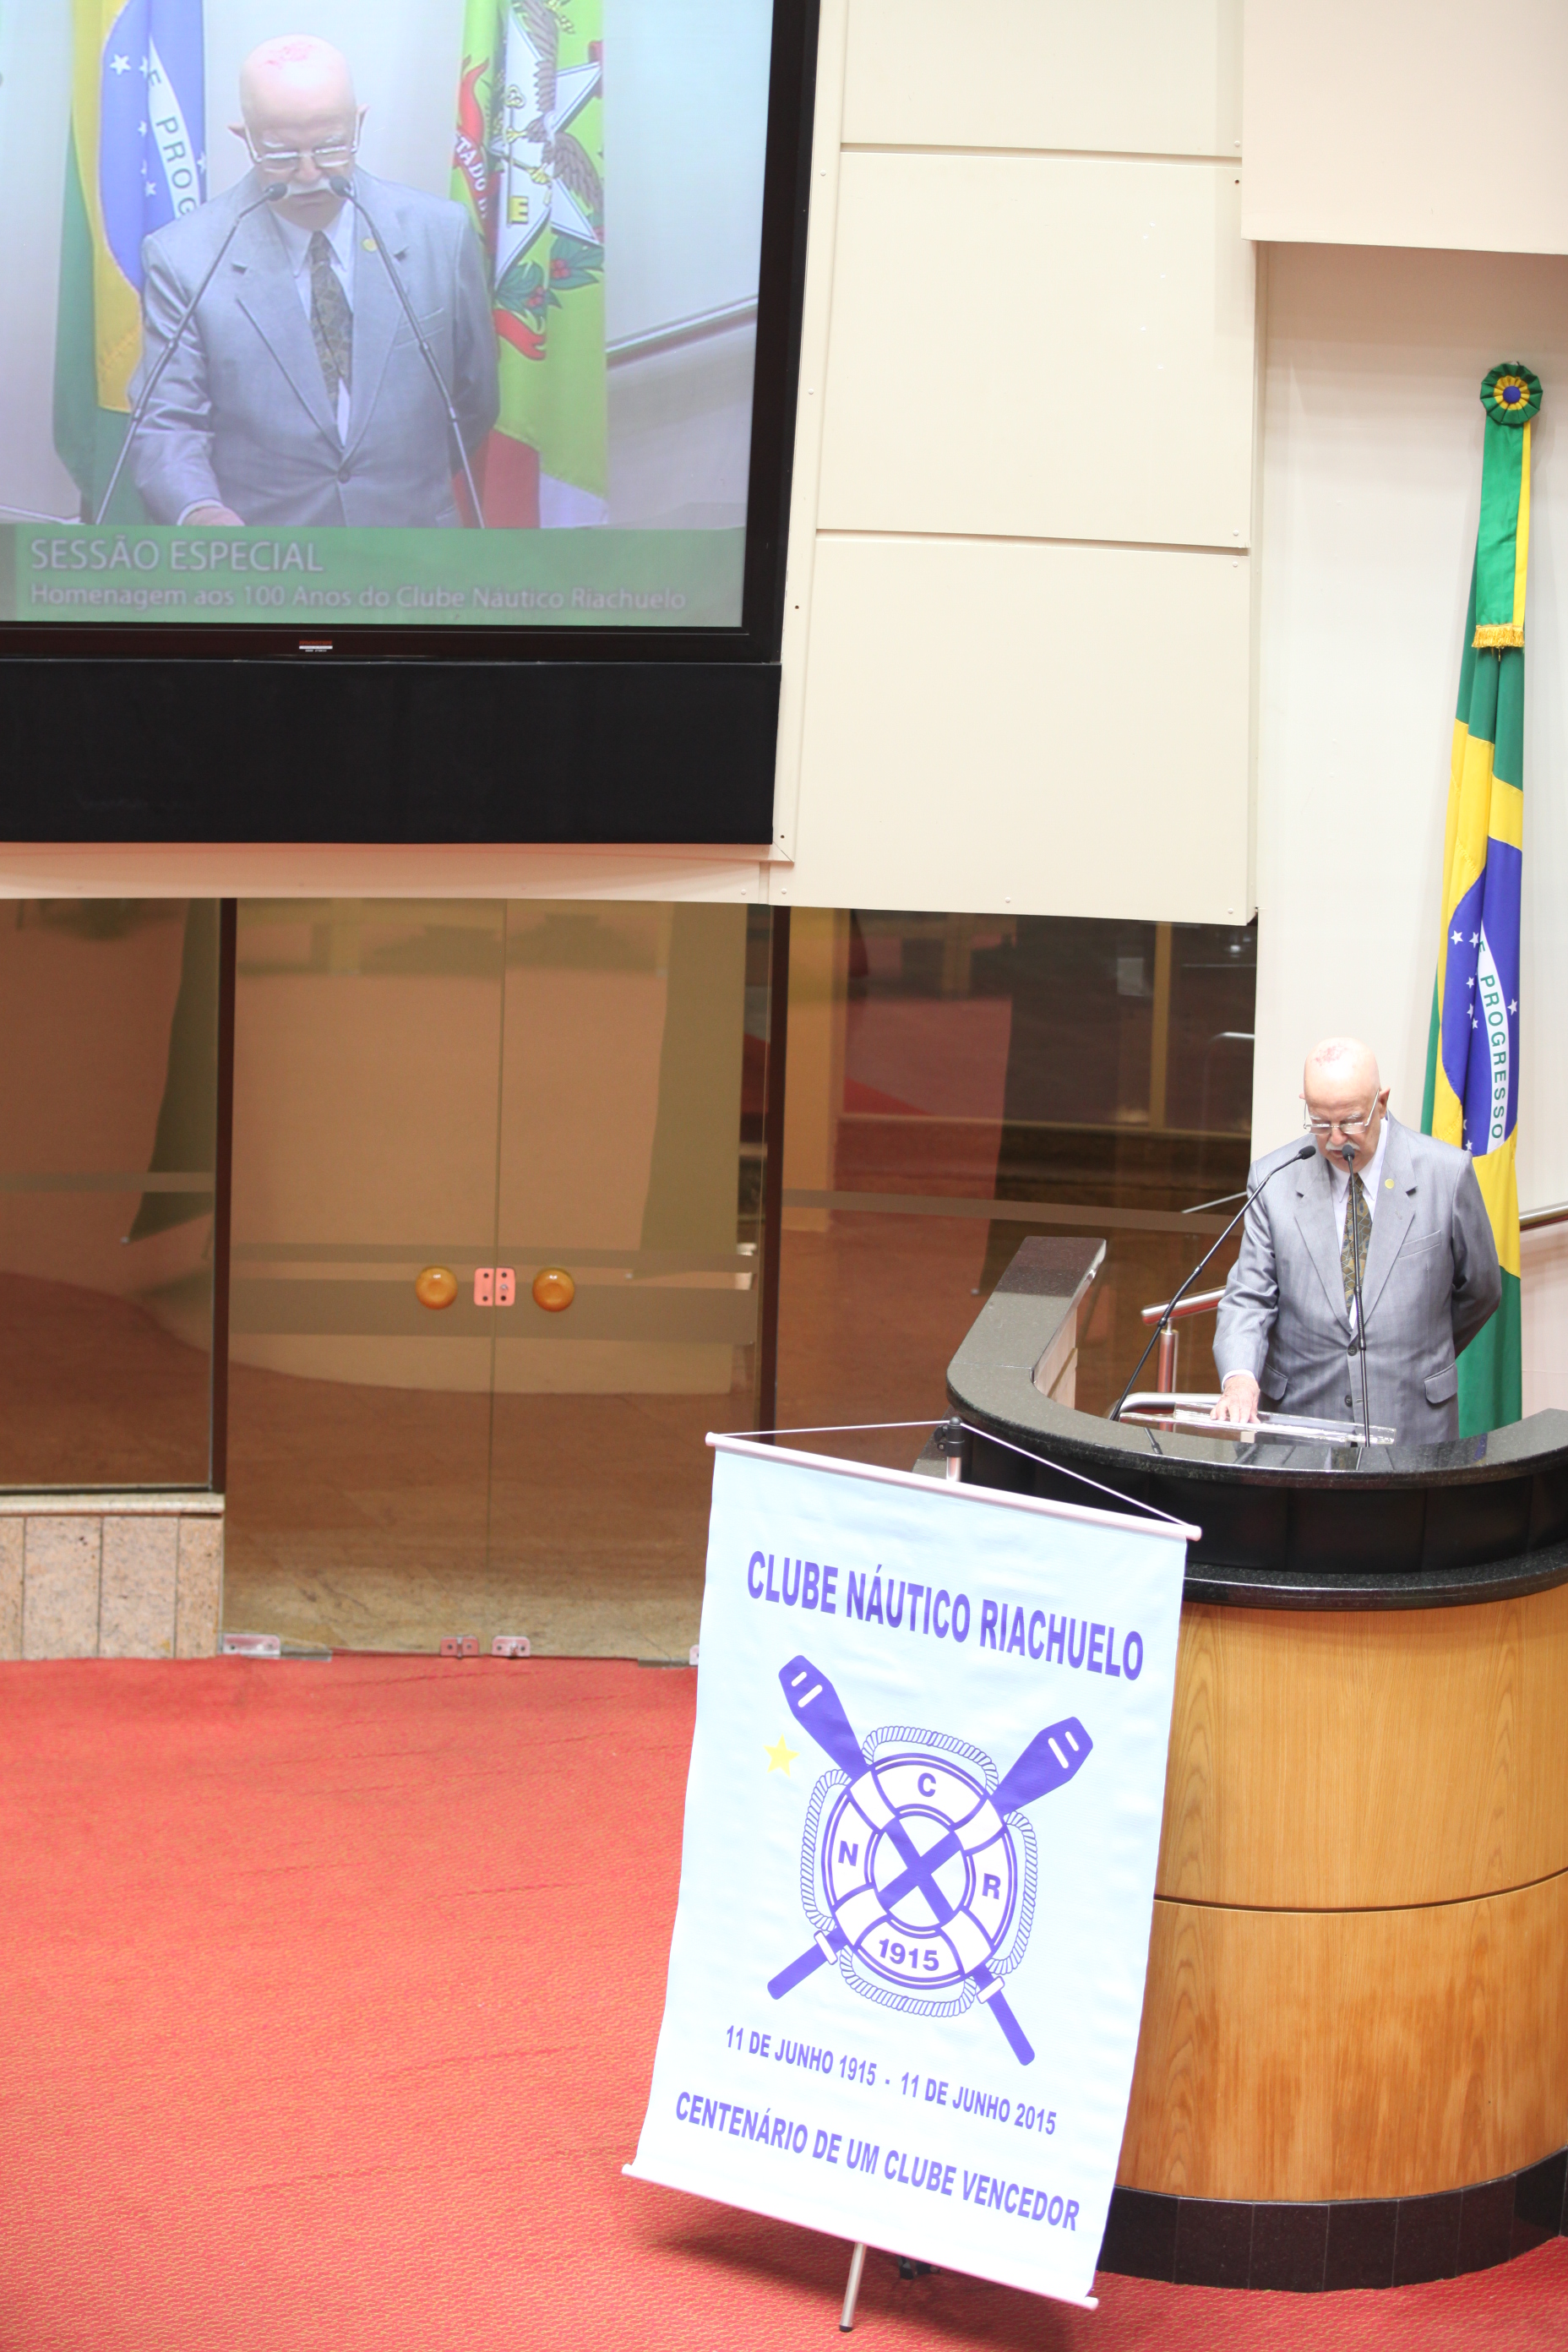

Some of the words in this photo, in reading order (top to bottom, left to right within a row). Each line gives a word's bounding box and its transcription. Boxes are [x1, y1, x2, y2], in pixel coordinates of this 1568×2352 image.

[30, 535, 160, 570] SESSÃO
[171, 540, 324, 572] ESPECIAL
[30, 583, 188, 612] Homenagem
[193, 589, 235, 607] aos
[244, 585, 286, 607] 100
[292, 585, 351, 607] Anos
[359, 585, 390, 608] do
[396, 585, 466, 608] Clube
[472, 586, 564, 609] Náutico
[571, 586, 687, 610] Riachuelo
[1480, 973, 1507, 1139] PROGRESSO
[747, 1550, 839, 1614] CLUBE
[846, 1564, 971, 1643] NÁUTICO
[979, 1598, 1144, 1681] RIACHUELO
[917, 1772, 937, 1797] C
[837, 1839, 859, 1866] N
[982, 1872, 1001, 1900] R
[879, 1938, 939, 1971] 1915
[726, 2024, 744, 2050] 11
[749, 2030, 771, 2058] DE
[774, 2039, 834, 2074] JUNHO
[839, 2055, 877, 2086] 1915
[901, 2072, 919, 2098] 11
[924, 2077, 949, 2106] DE
[952, 2086, 1010, 2123] JUNHO
[1014, 2102, 1057, 2135] 2015
[676, 2091, 808, 2153] CENTENÁRIO
[812, 2129, 842, 2164] DE
[846, 2138, 880, 2175] UM
[884, 2149, 957, 2197] CLUBE
[962, 2170, 1080, 2231] VENCEDOR
